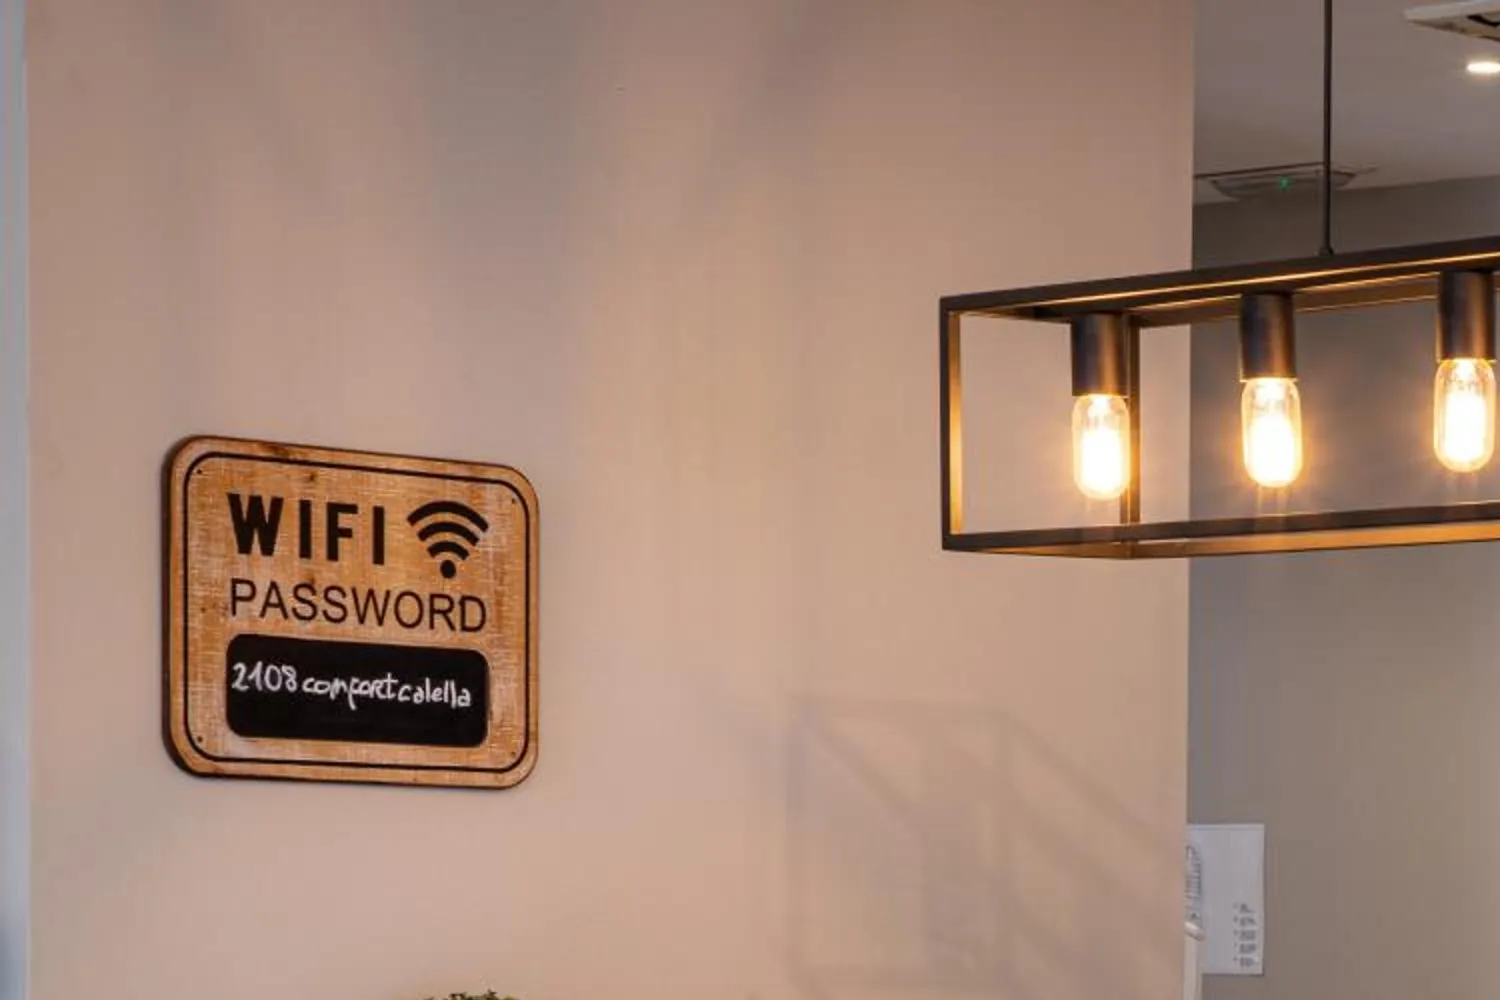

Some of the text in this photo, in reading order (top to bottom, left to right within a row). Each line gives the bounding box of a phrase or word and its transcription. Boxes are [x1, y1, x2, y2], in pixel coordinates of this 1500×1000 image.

[227, 493, 385, 566] WIFI
[230, 578, 487, 633] PASSWORD
[231, 661, 298, 692] 2108
